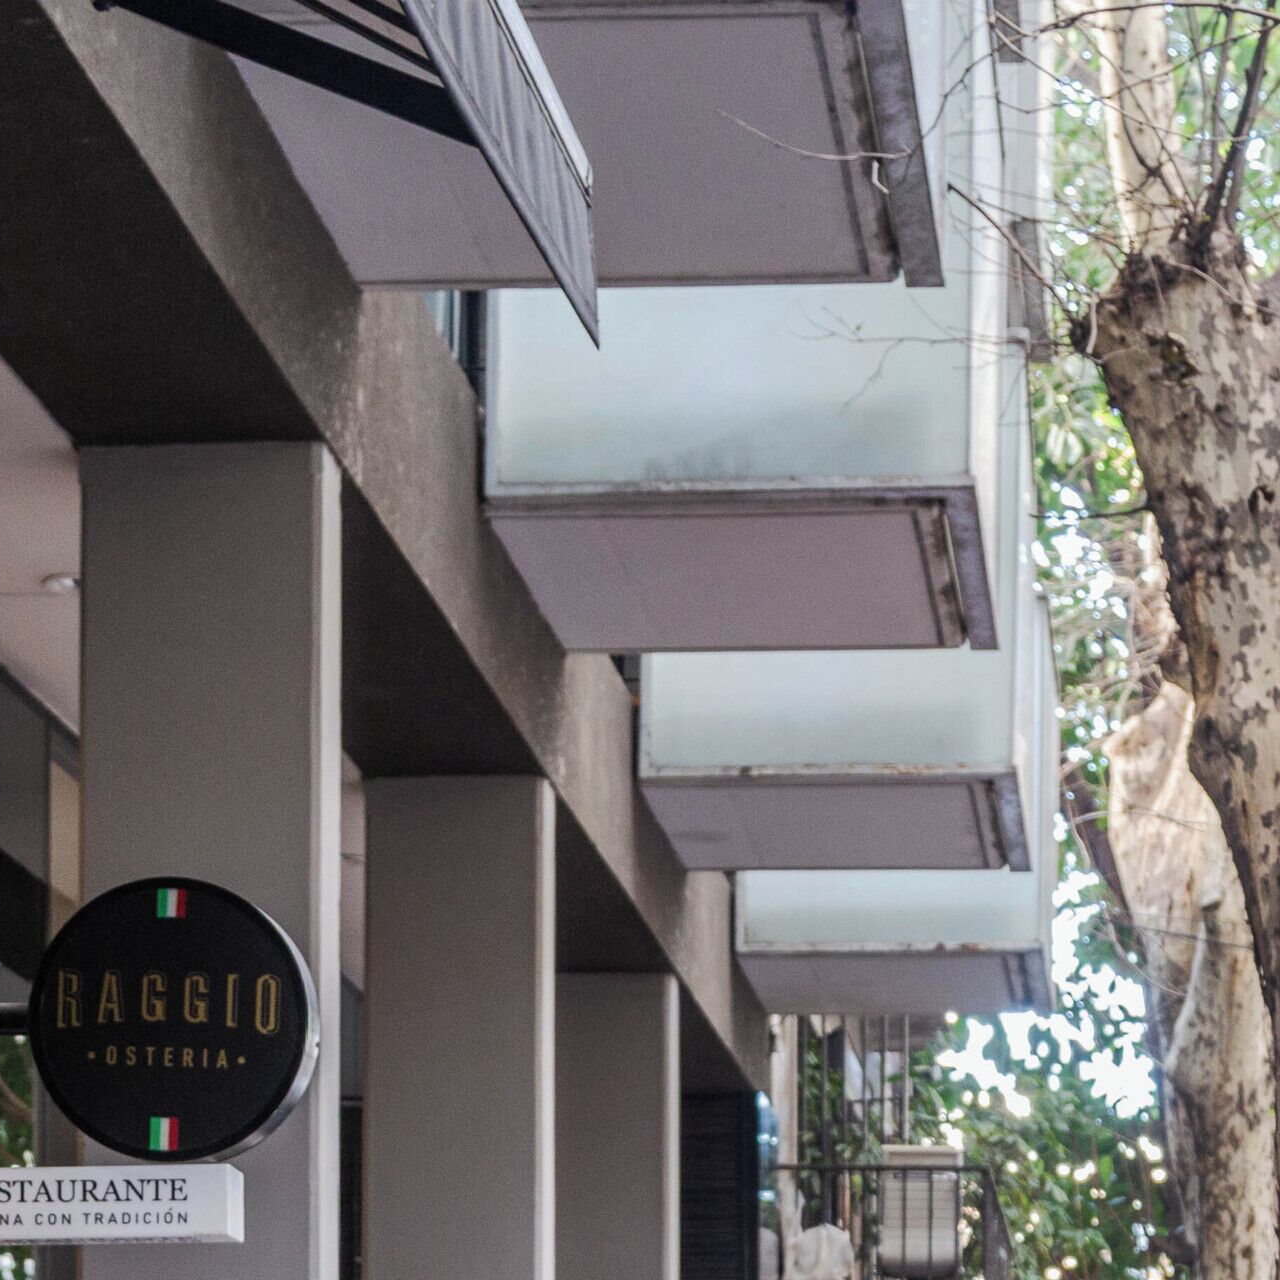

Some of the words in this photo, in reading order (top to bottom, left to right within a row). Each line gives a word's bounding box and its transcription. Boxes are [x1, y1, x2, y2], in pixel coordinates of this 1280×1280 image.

[55, 968, 283, 1035] RAGGIO
[106, 1044, 229, 1069] OSTERIA
[34, 1212, 72, 1226] CON
[82, 1207, 189, 1225] TRADICIÓN
